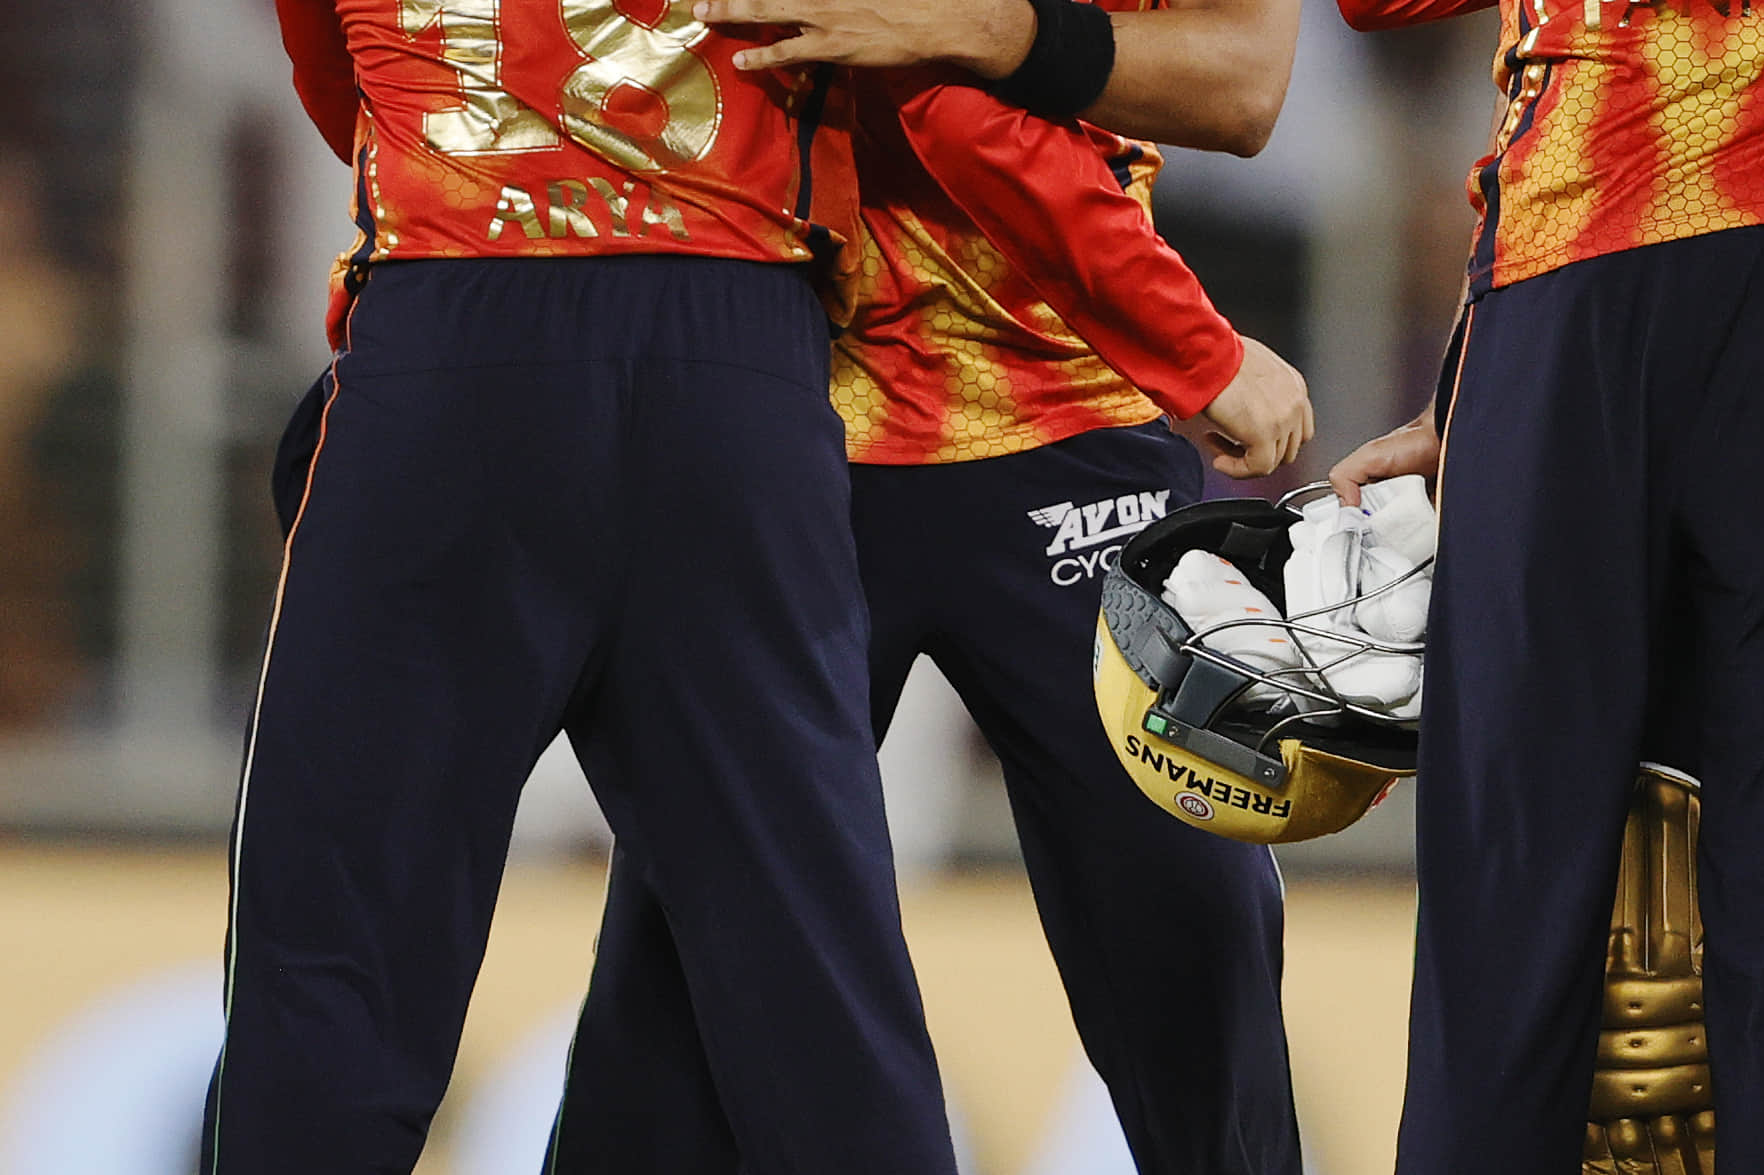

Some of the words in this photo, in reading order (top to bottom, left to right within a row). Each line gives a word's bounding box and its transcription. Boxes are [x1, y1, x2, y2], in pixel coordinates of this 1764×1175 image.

[486, 176, 692, 241] ARYA
[1028, 488, 1172, 556] AVON
[1051, 545, 1123, 586] CYC
[1125, 733, 1292, 818] FREEMANS
